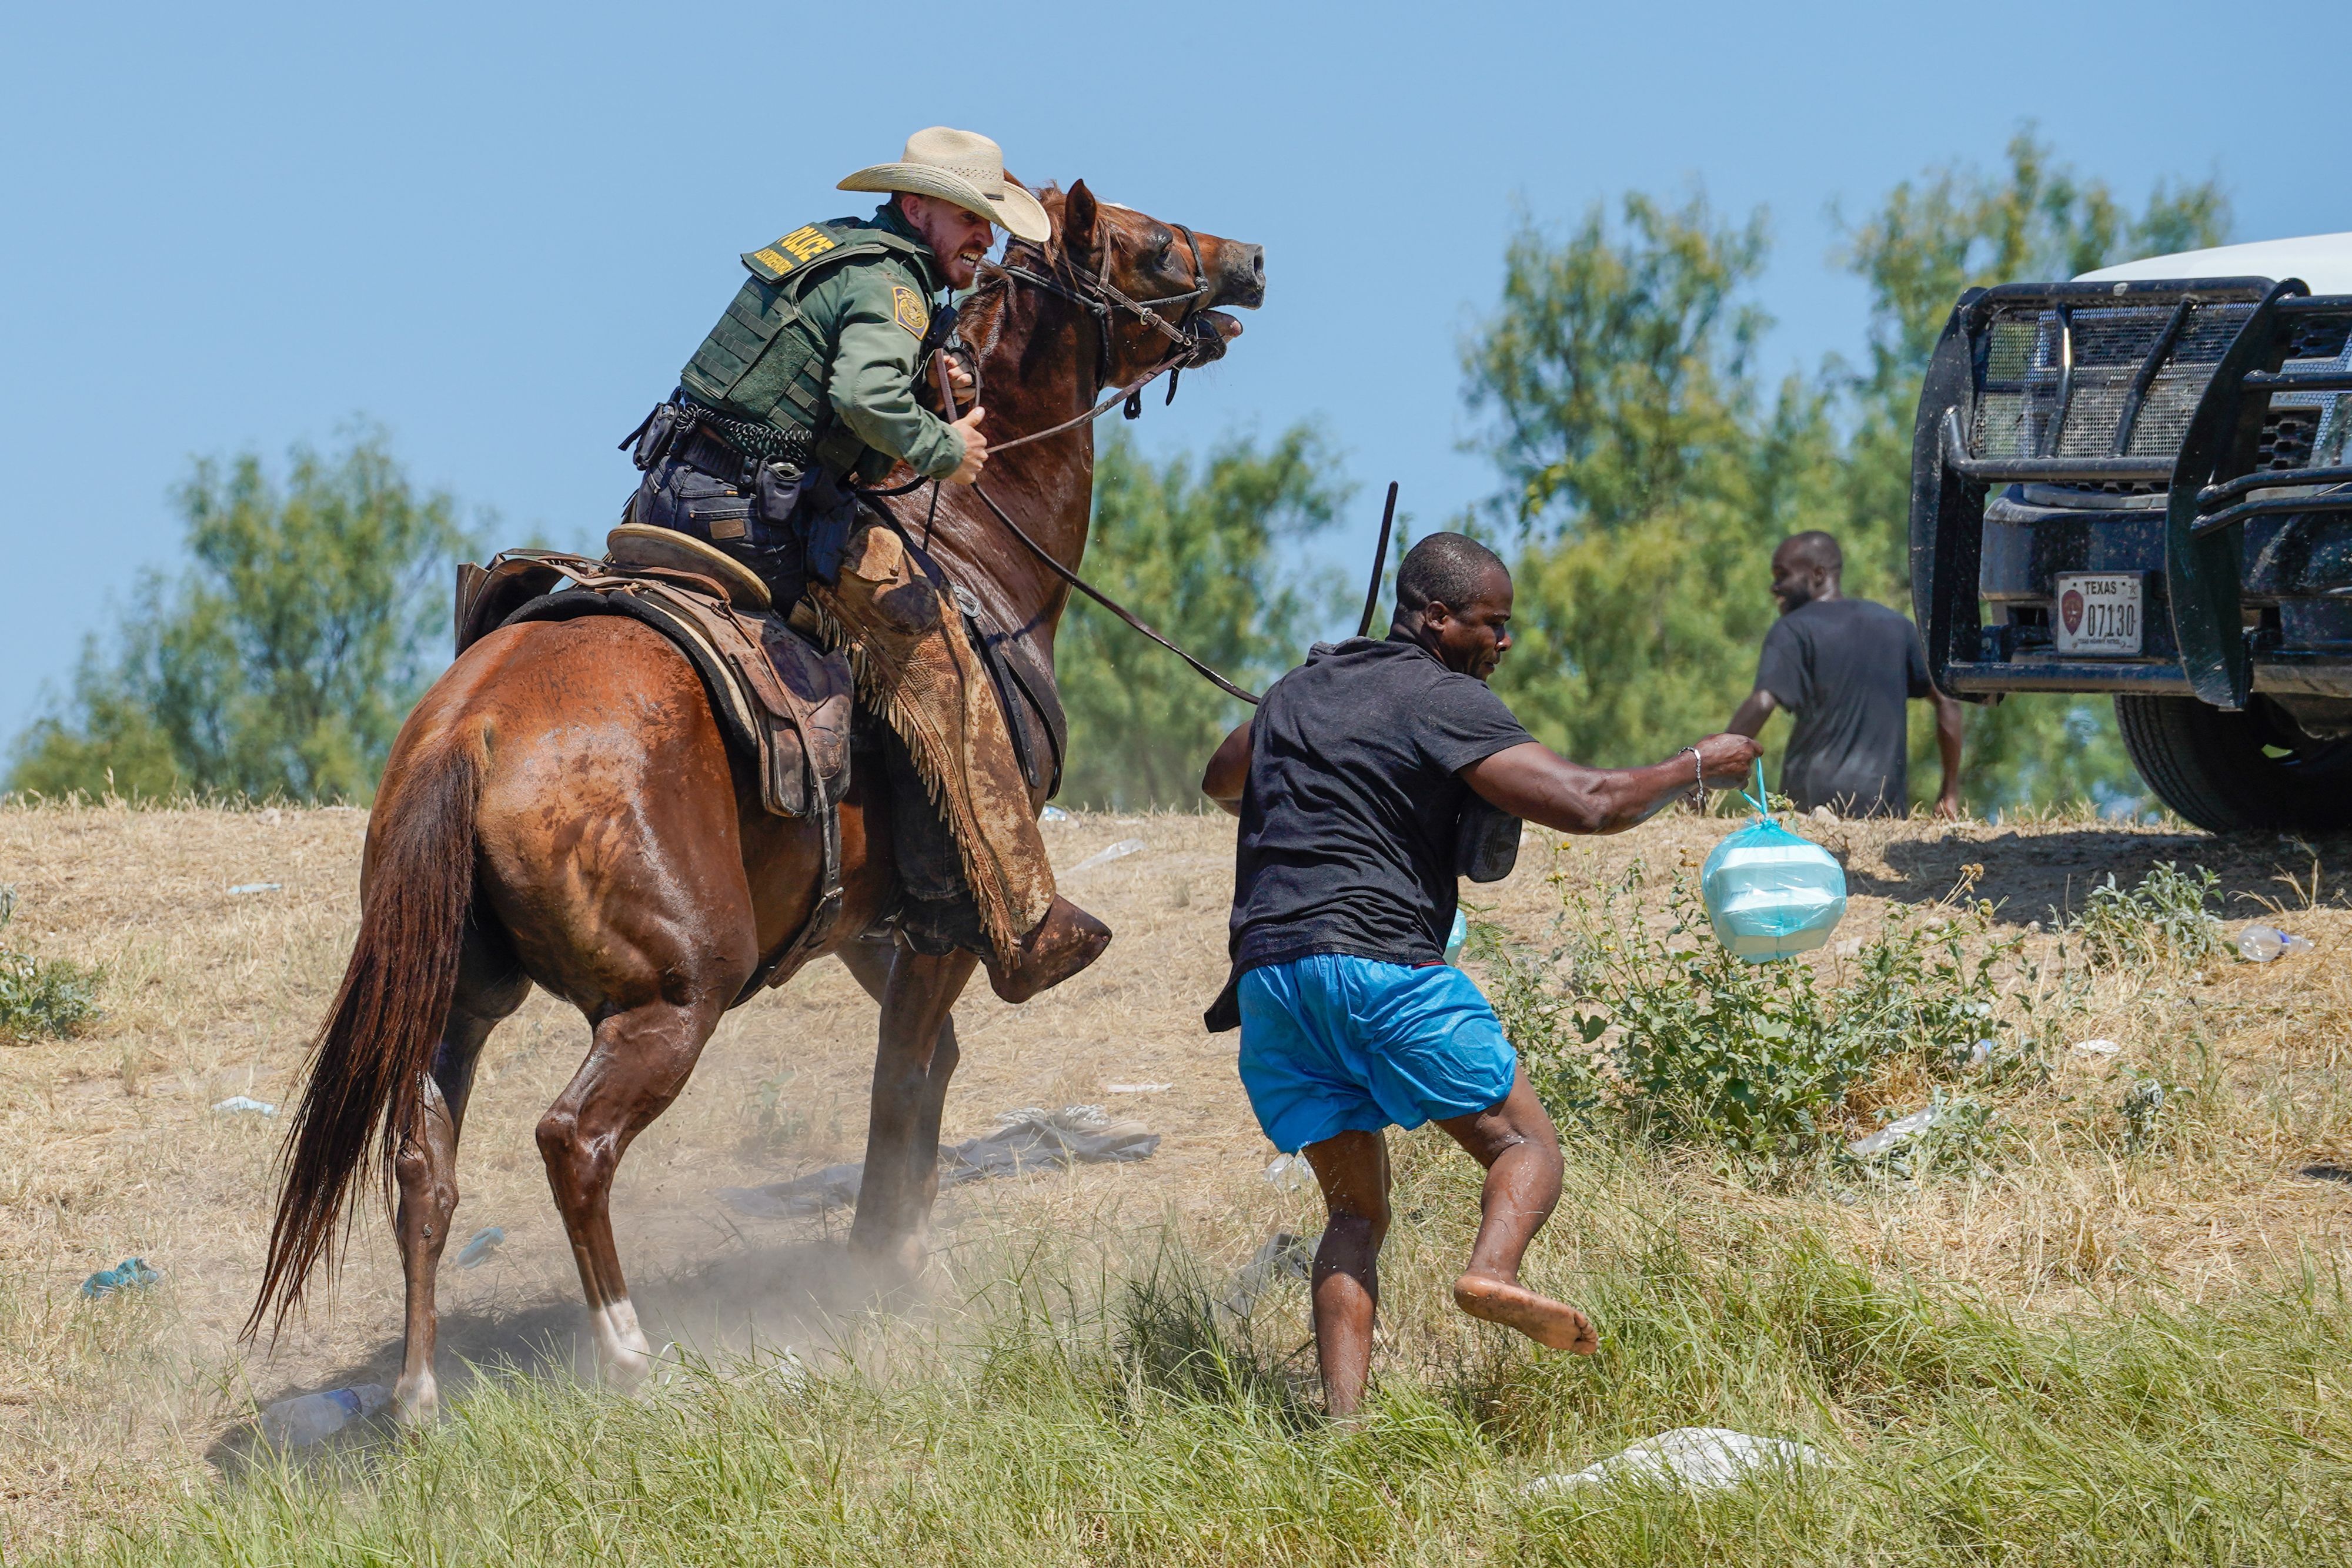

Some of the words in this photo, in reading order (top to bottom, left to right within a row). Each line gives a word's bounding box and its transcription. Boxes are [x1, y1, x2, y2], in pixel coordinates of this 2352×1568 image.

[777, 226, 835, 262] POLICE
[2084, 581, 2117, 594] TEXAS
[2088, 604, 2134, 637] 07130
